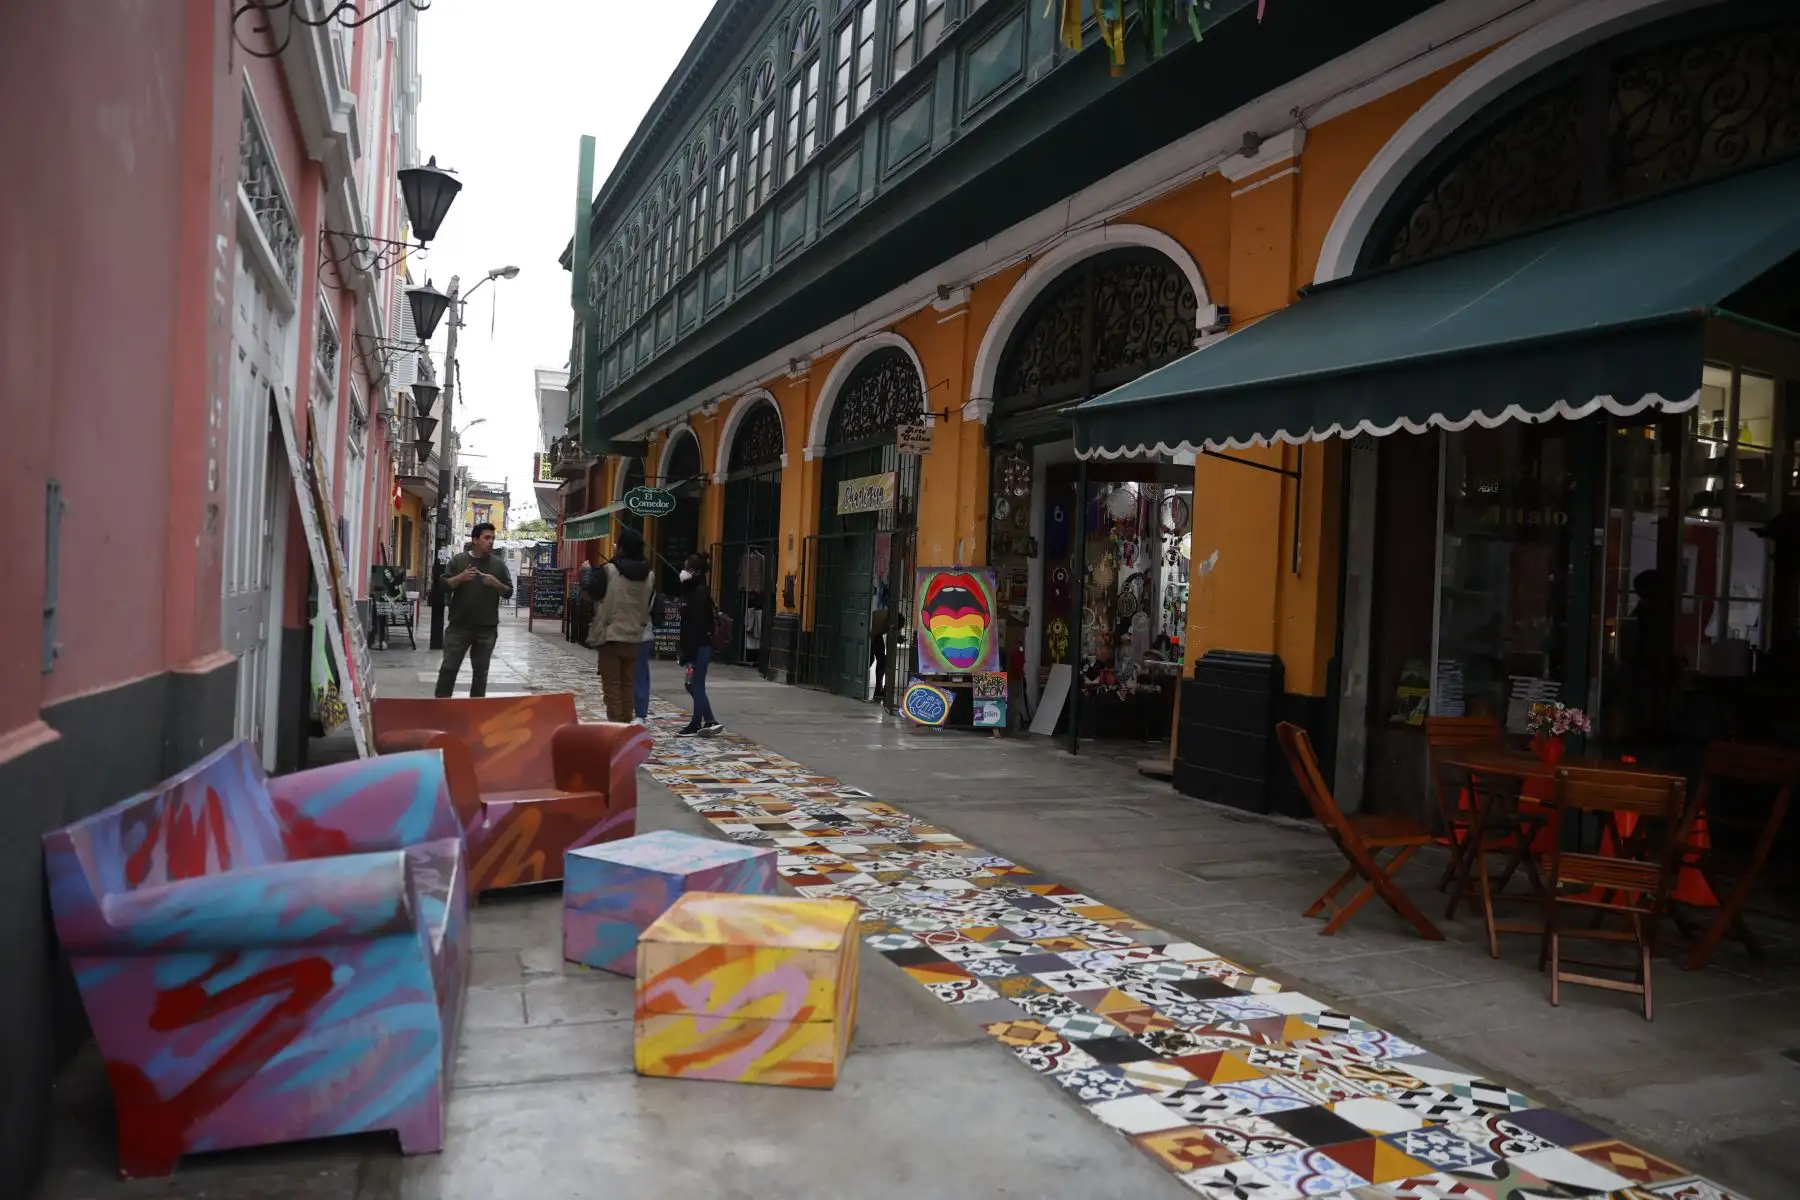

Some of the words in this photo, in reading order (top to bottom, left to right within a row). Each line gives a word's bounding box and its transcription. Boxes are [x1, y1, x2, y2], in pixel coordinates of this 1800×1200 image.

[905, 426, 926, 435] Arte
[629, 497, 670, 508] Comedor
[977, 685, 1004, 697] NEON
